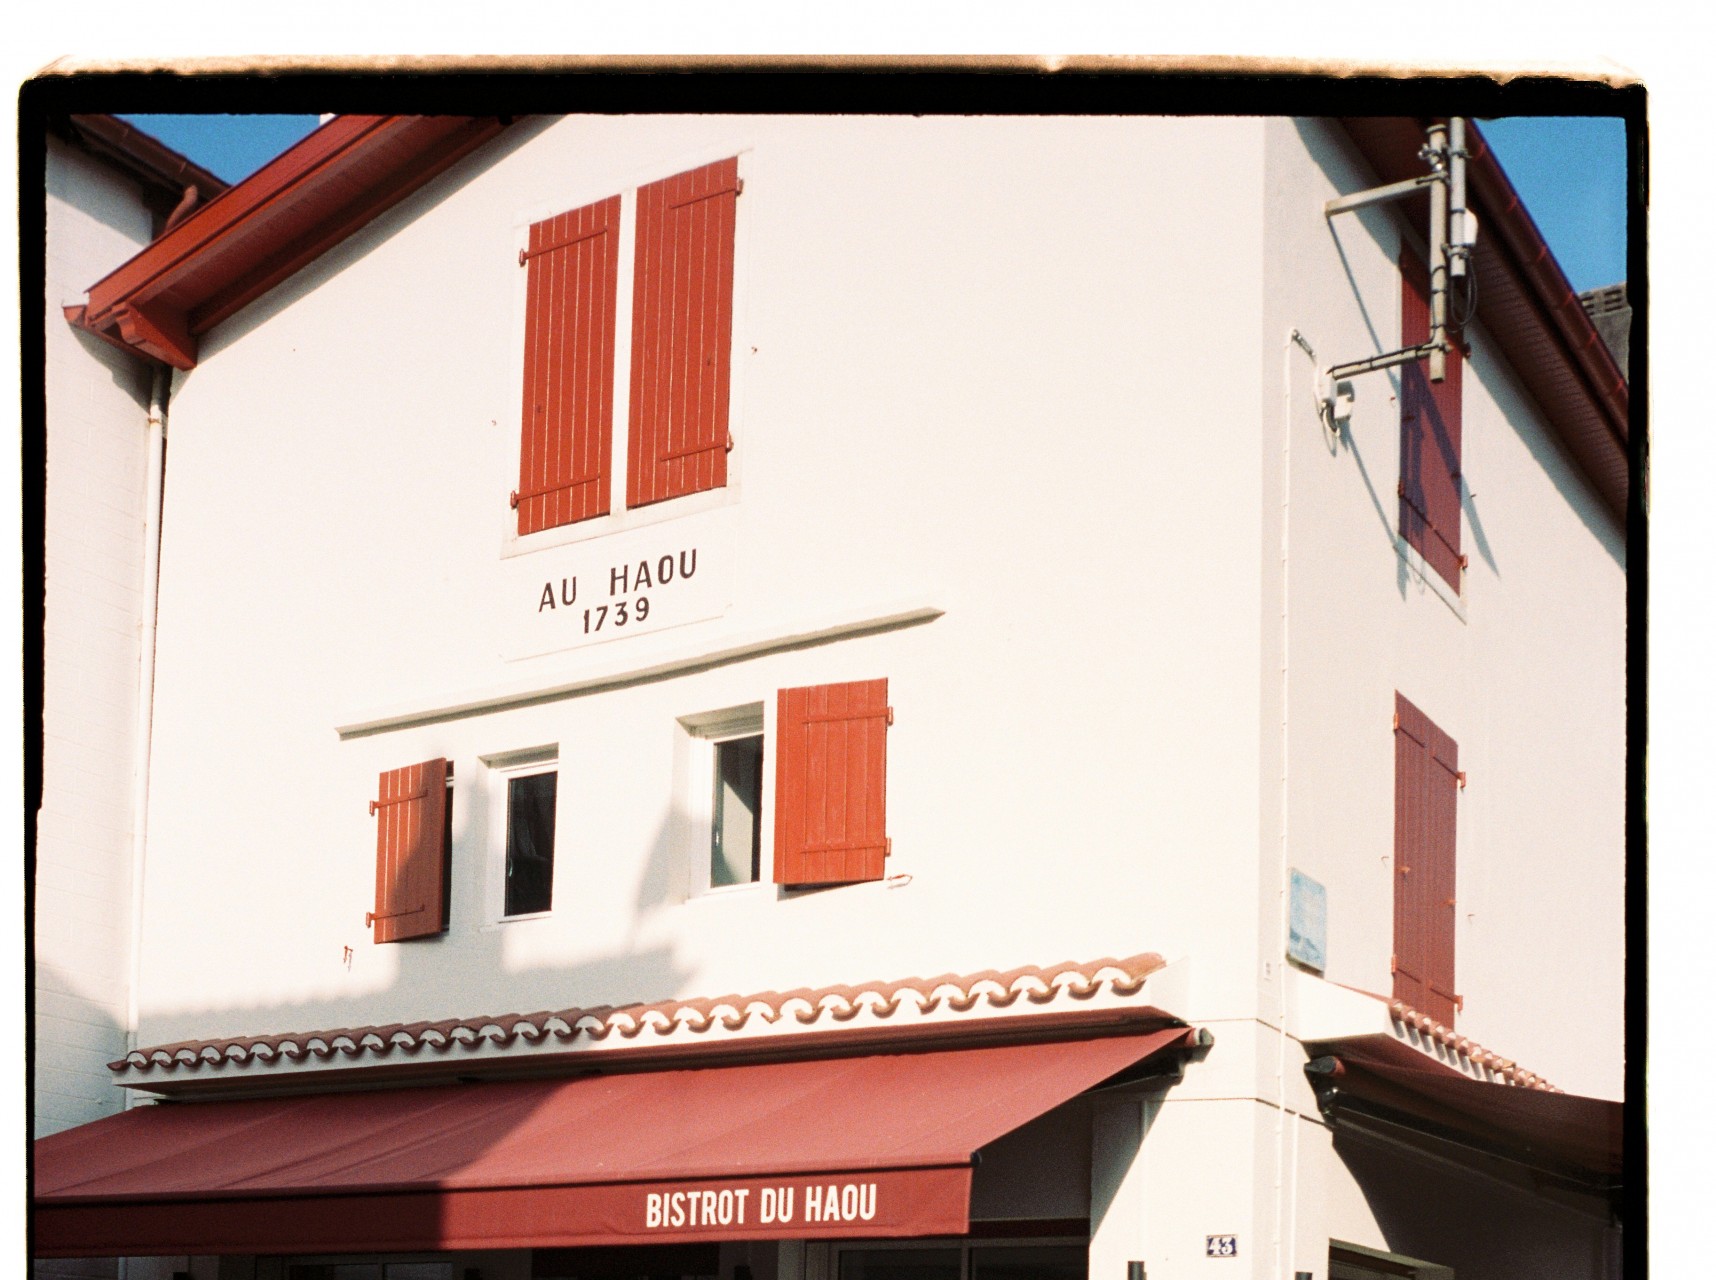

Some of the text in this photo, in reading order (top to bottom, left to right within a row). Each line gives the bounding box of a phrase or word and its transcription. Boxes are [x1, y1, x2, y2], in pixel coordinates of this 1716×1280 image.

[538, 548, 697, 612] AU HAOU
[583, 596, 650, 634] 1739
[646, 1183, 877, 1228] BISTROT DU HAOU
[1208, 1236, 1234, 1256] 43
